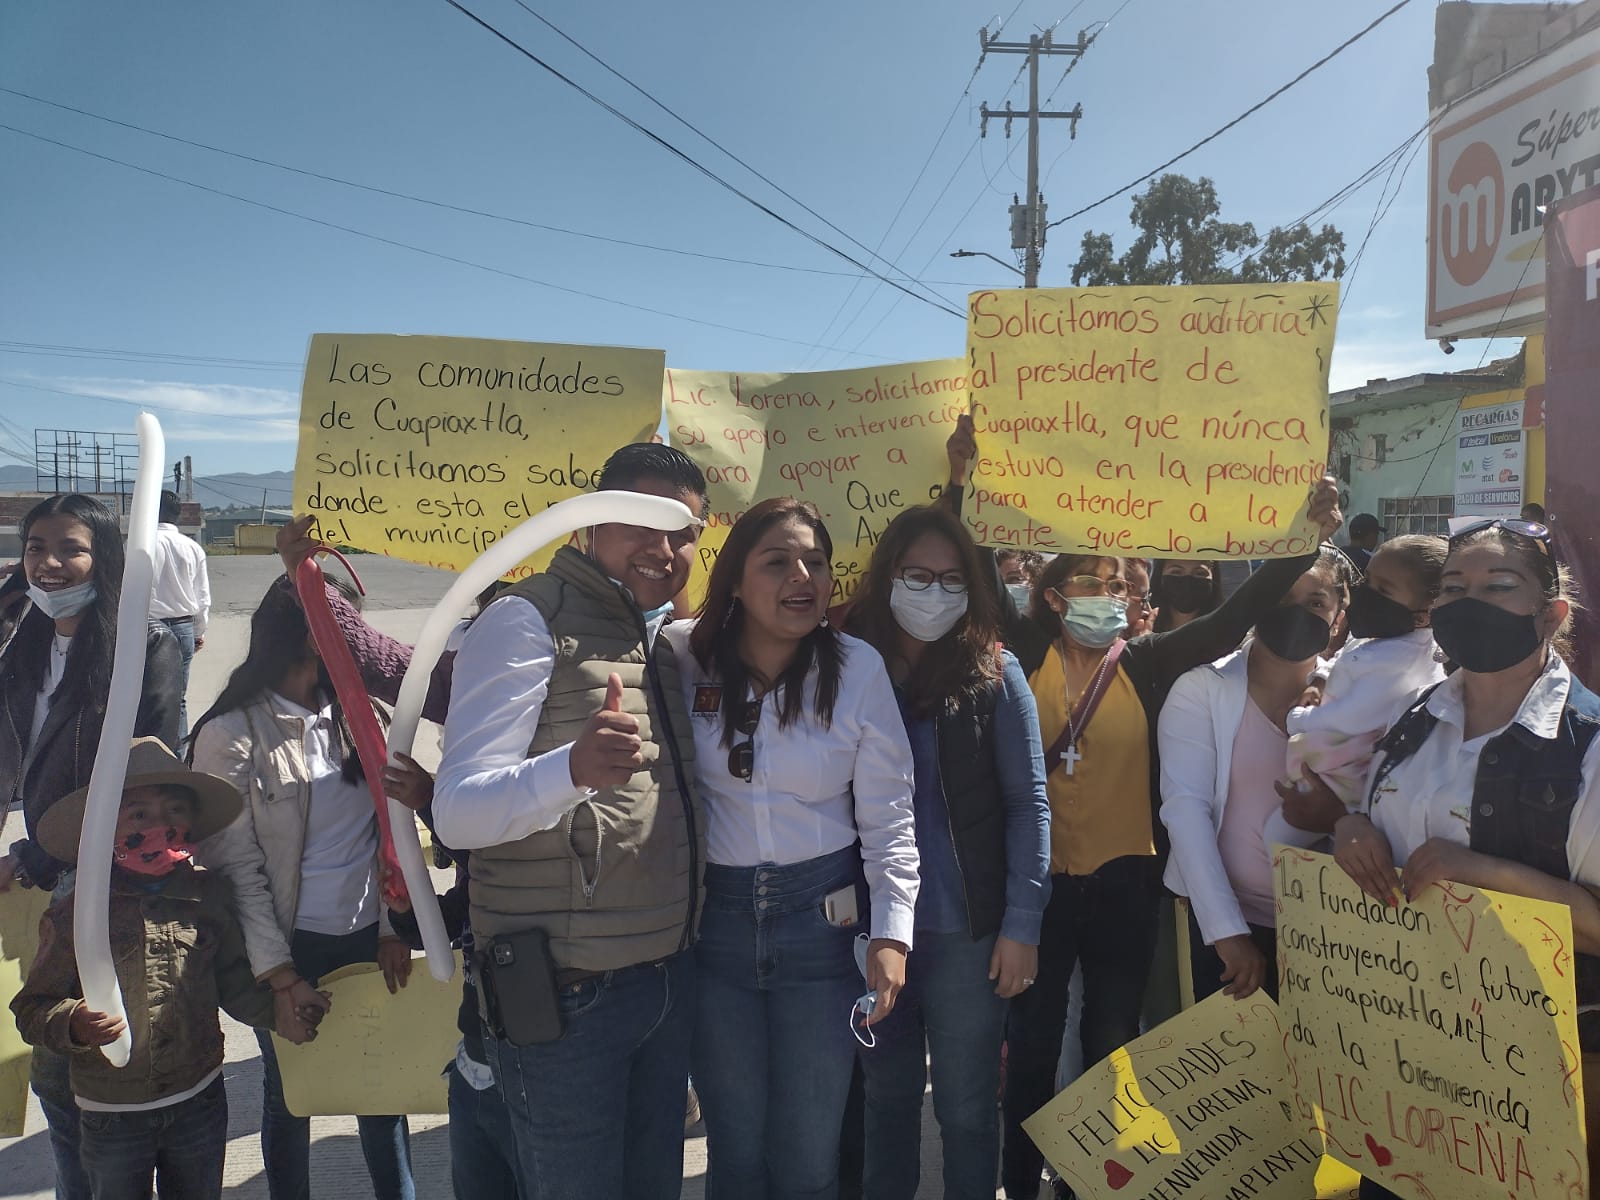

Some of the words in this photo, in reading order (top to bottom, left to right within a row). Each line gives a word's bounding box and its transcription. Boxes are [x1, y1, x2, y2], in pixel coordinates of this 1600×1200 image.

[975, 292, 1159, 338] Solicitamos
[328, 344, 392, 386] Las
[418, 356, 625, 396] comunidades
[666, 368, 717, 408] Lic.
[735, 375, 835, 412] Lorena,
[847, 372, 968, 404] solicitamo
[972, 351, 997, 389] al
[1017, 347, 1159, 400] presidente
[1186, 346, 1239, 385] de
[320, 401, 354, 430] de
[374, 397, 529, 447] Cuapiaxtla,
[724, 427, 786, 454] apoyo
[807, 427, 826, 442] e
[973, 401, 1106, 444] Cuapiaxtla,
[1124, 413, 1180, 448] que
[1202, 410, 1310, 444] núnca
[1462, 408, 1519, 428] RECARGAS
[527, 453, 603, 489] sabe
[706, 463, 751, 485] ara
[780, 452, 863, 491] apoyar
[887, 447, 908, 465] a
[977, 450, 1064, 478] estuvo
[1096, 460, 1136, 481] en
[1159, 452, 1193, 486] la
[1206, 450, 1326, 495] presidencia
[307, 481, 389, 514] donde
[416, 493, 486, 518] esta
[504, 493, 532, 519] el
[847, 480, 905, 512] Que
[976, 487, 1027, 514] para
[1057, 485, 1163, 519] atender
[1190, 501, 1208, 523] a
[1248, 494, 1278, 528] la
[307, 519, 352, 543] del
[385, 520, 508, 553] municipi
[974, 519, 1055, 546] gente
[1087, 526, 1133, 551] que
[1168, 529, 1192, 553] lo
[1280, 856, 1305, 903] La
[1287, 967, 1311, 993] por
[1441, 962, 1463, 995] el
[1480, 957, 1560, 1017] futuro
[1293, 1008, 1317, 1049] da
[1337, 1022, 1369, 1071] la
[1067, 1030, 1256, 1157] FELICIDADES
[1132, 1132, 1172, 1164] LIC
[1175, 1079, 1272, 1133] LORENA,
[1385, 1089, 1539, 1199] LORENA
